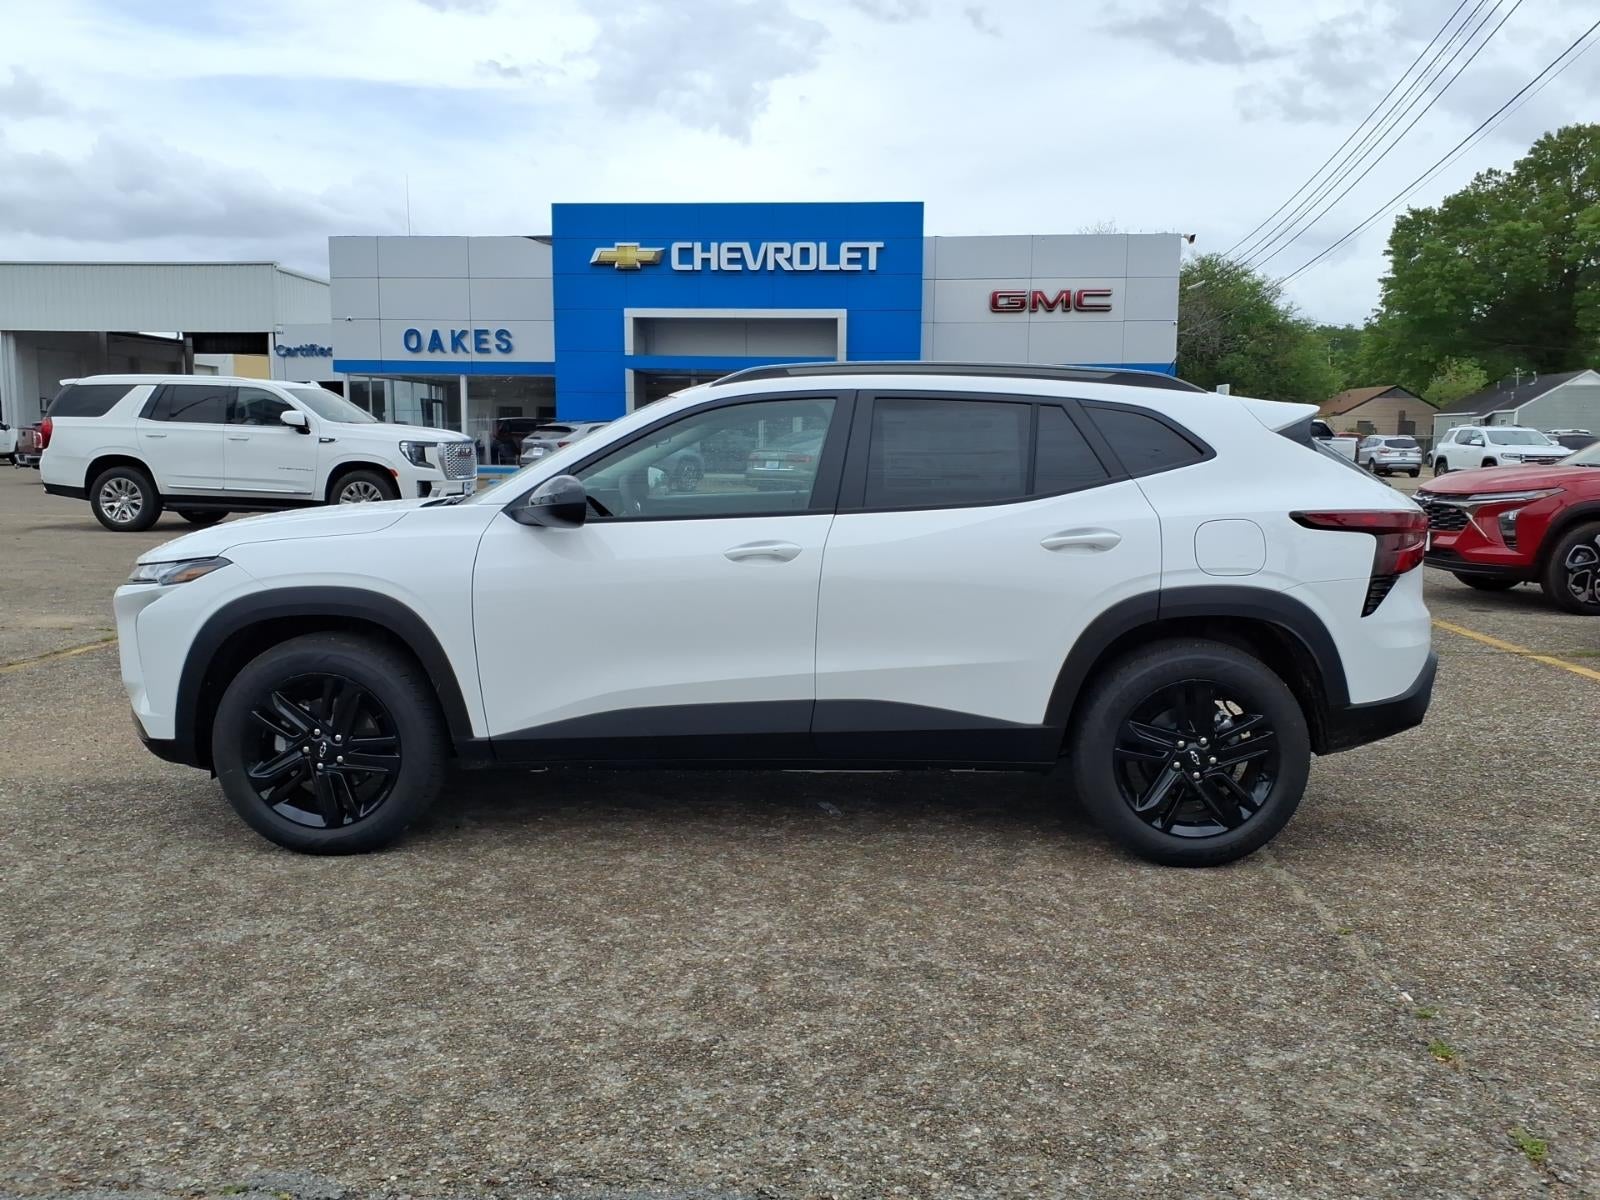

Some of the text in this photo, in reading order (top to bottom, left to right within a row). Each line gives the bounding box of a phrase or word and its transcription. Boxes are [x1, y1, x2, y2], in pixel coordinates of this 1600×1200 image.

[670, 241, 885, 271] CHEVROLET
[991, 290, 1112, 312] GMC
[403, 328, 513, 354] OAKES
